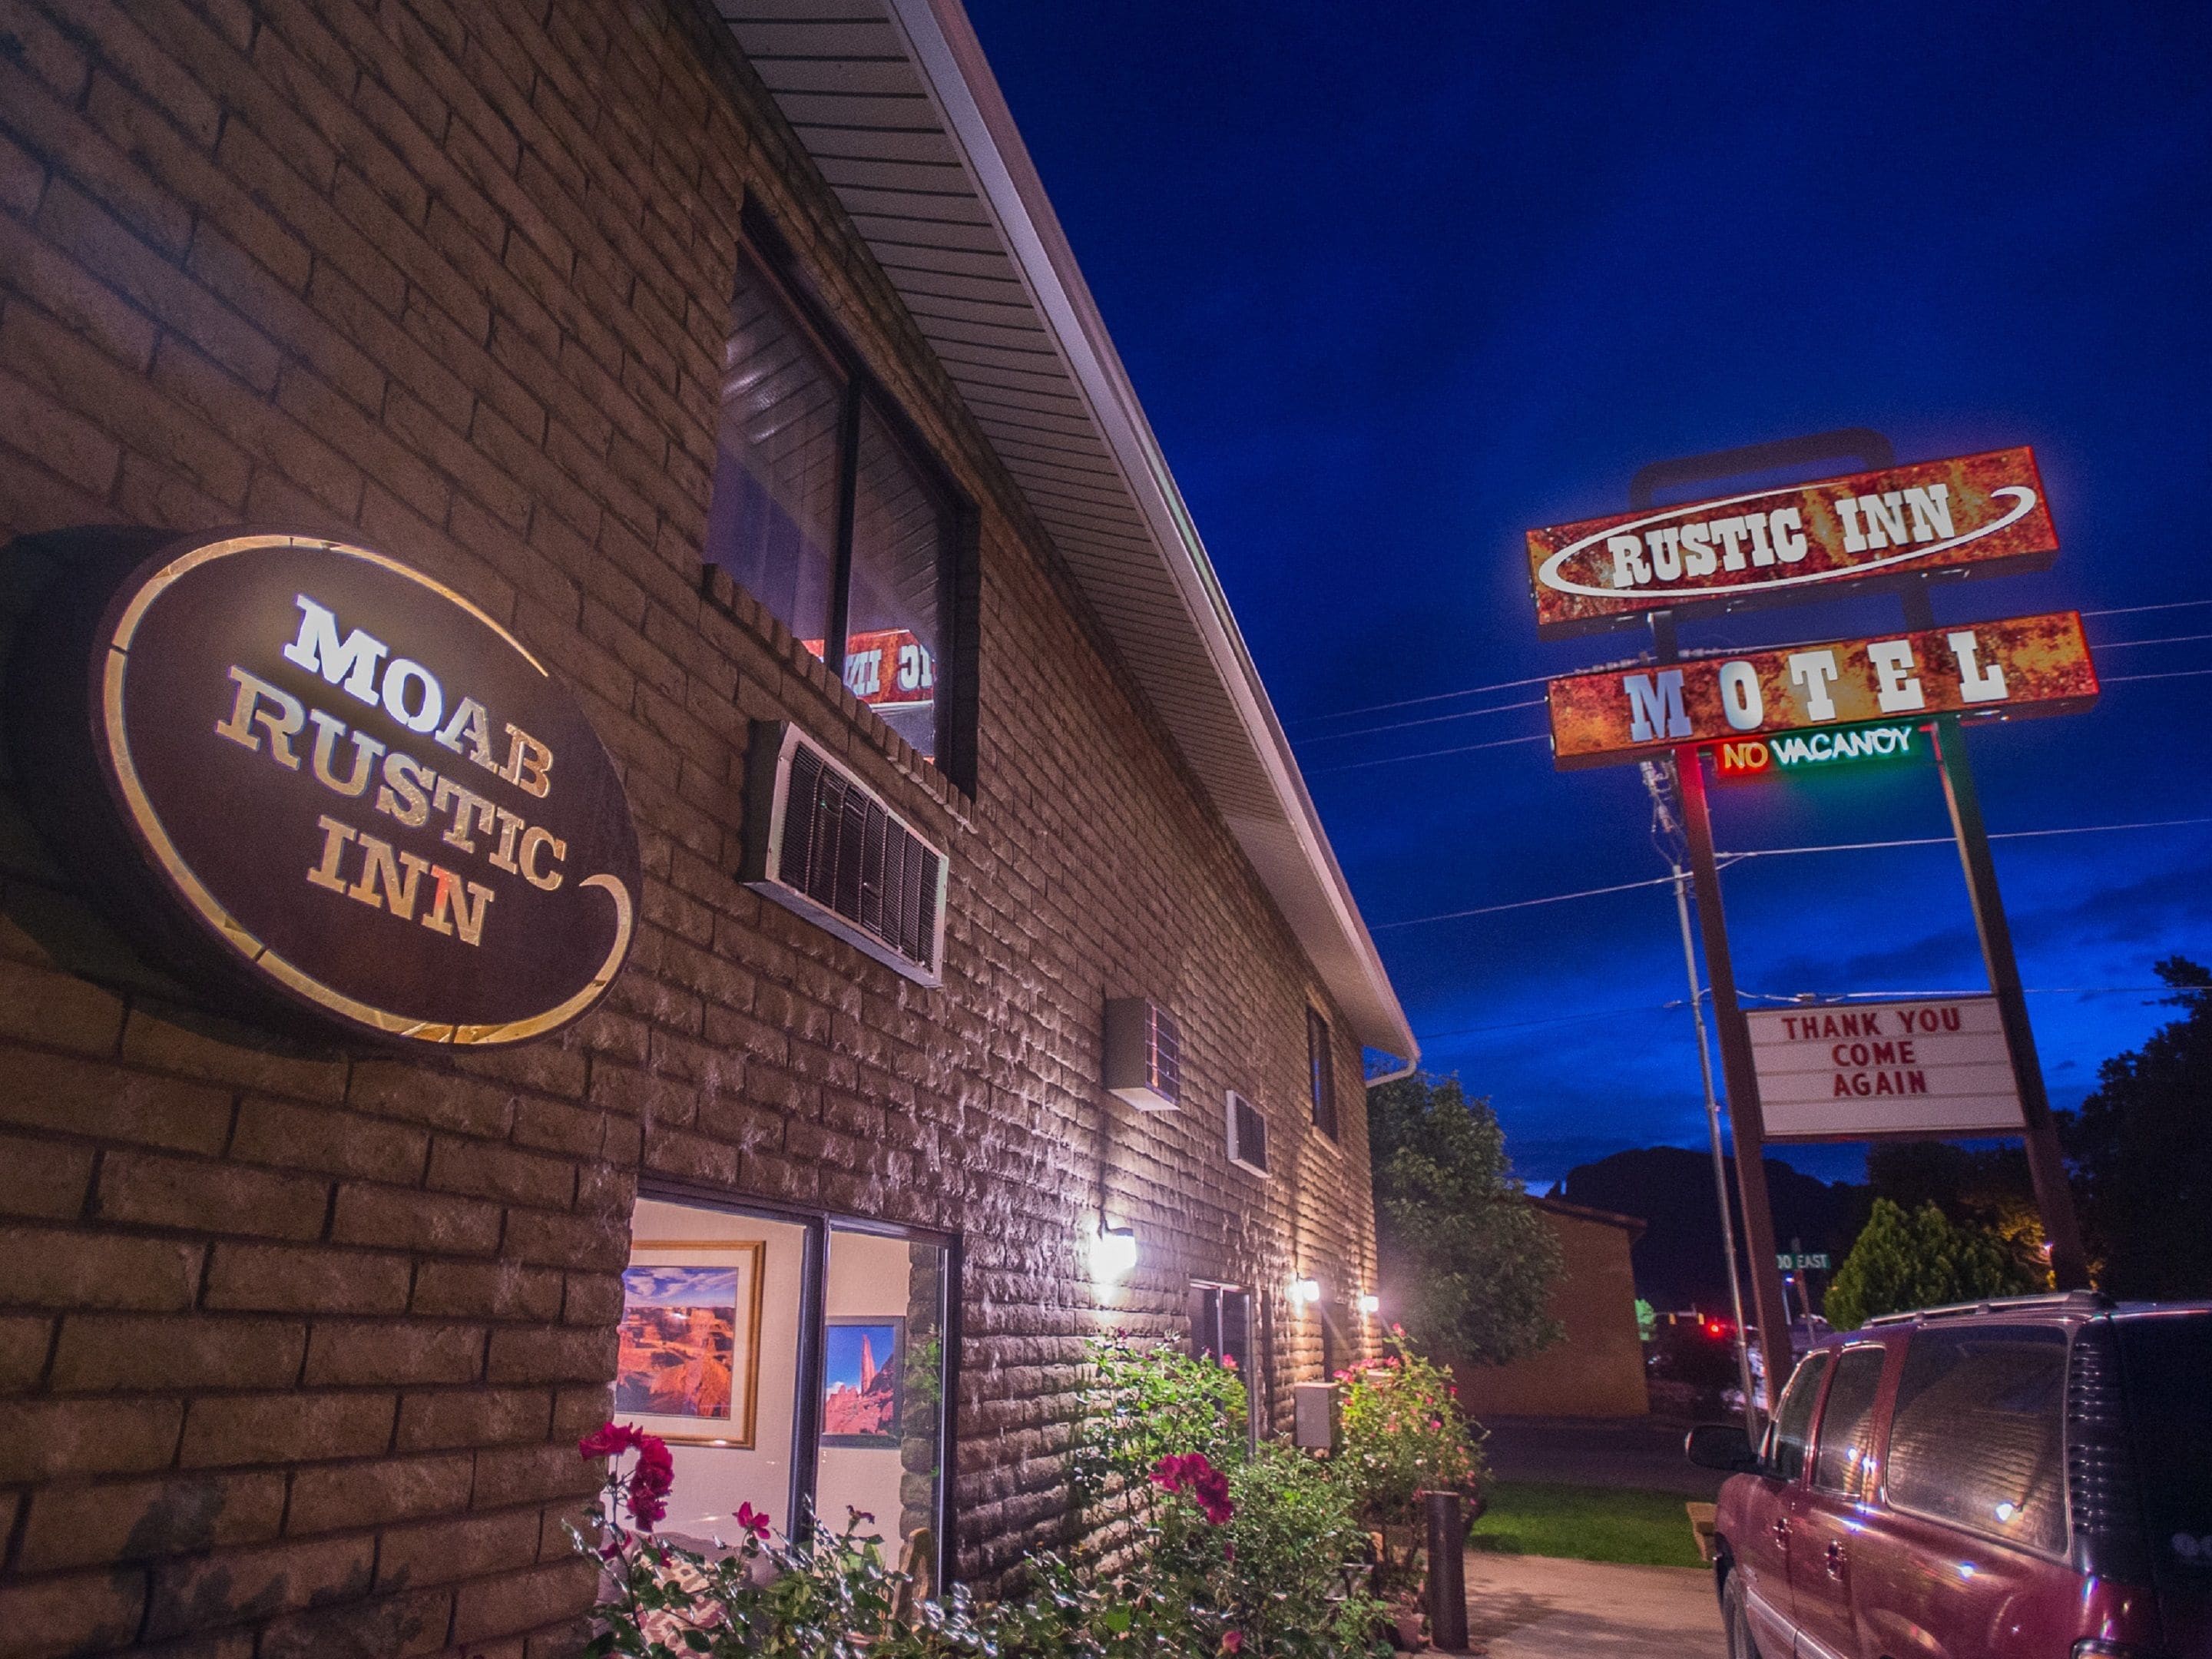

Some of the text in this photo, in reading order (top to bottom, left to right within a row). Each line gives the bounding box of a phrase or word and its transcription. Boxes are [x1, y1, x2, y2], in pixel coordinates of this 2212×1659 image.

[1606, 482, 1956, 589] RUSTIC INN
[283, 593, 554, 799] MOAB
[1623, 630, 2009, 743] MOTEL
[215, 664, 568, 891] RUSTIC
[1723, 741, 1769, 769] NO
[306, 813, 495, 946] INN
[1781, 1007, 1962, 1040] THANK YOU
[1832, 1041, 1916, 1067] COME
[1833, 1070, 1927, 1097] AGAIN
[1797, 1253, 1826, 1269] EAST
